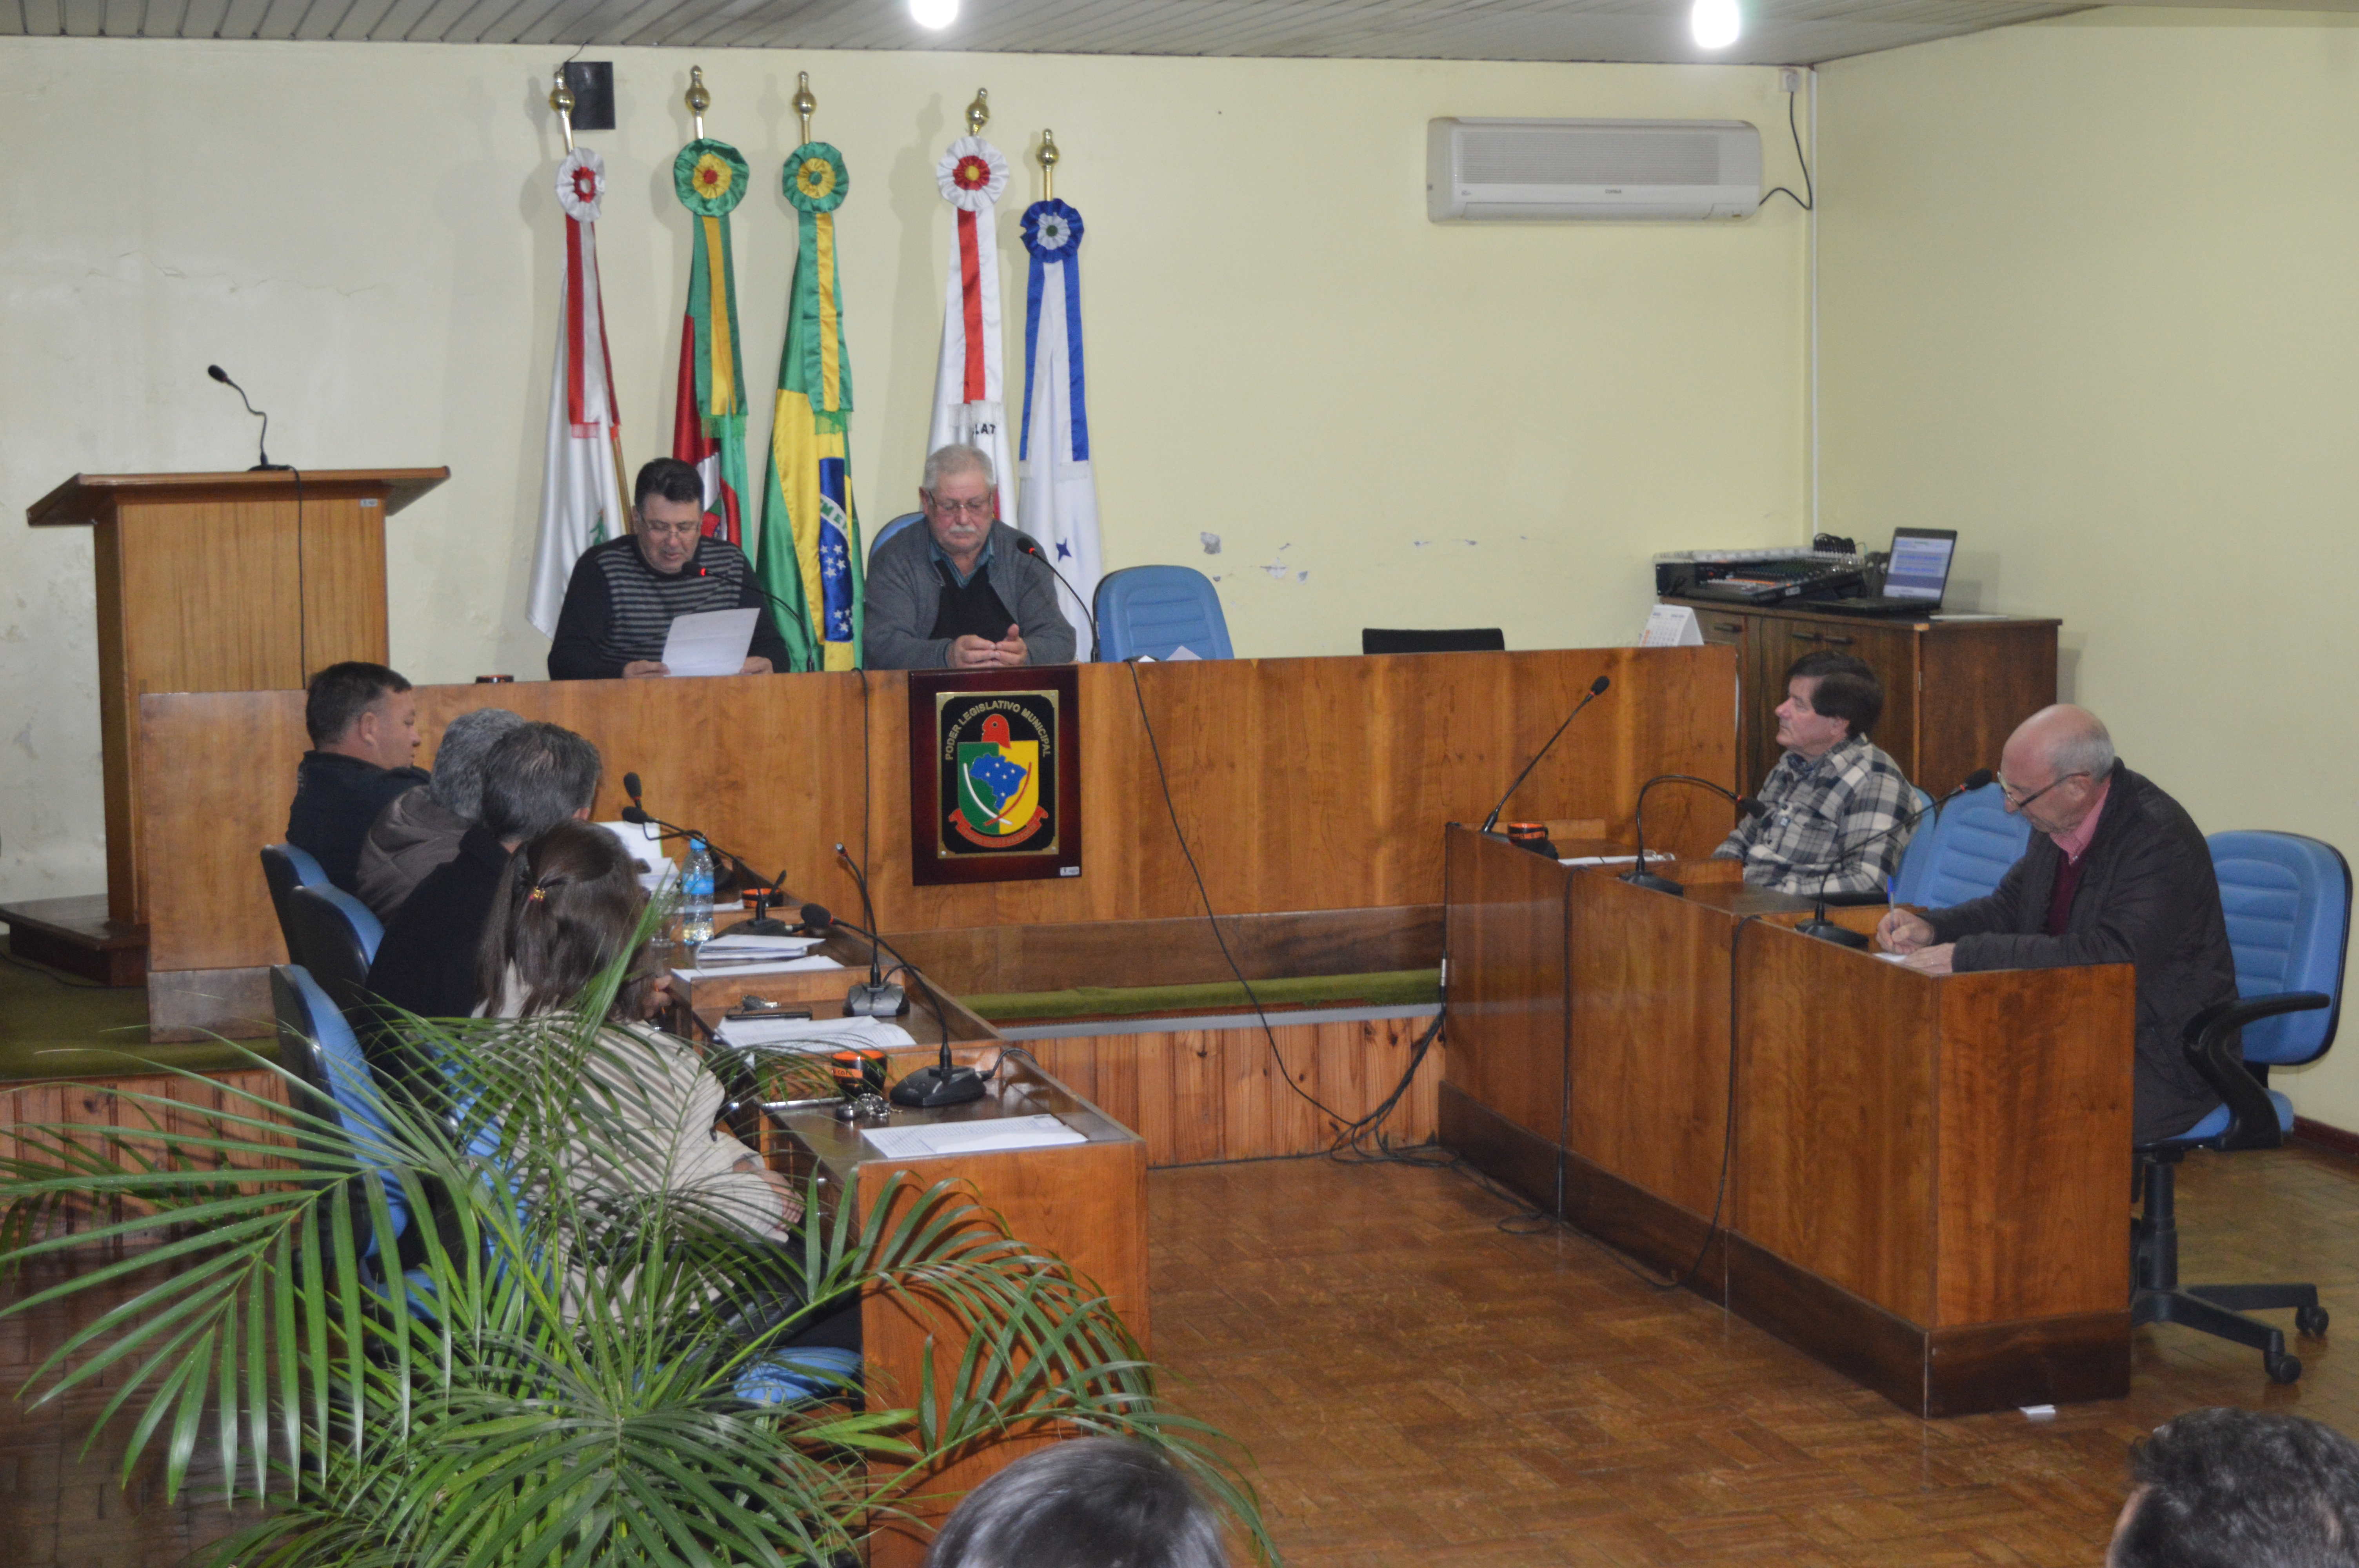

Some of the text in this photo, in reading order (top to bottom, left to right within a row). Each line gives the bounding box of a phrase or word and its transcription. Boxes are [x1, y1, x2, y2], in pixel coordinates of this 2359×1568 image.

[972, 423, 996, 434] LAT
[945, 700, 1050, 760] PODER LEGISLATIVO MUNICIPAL
